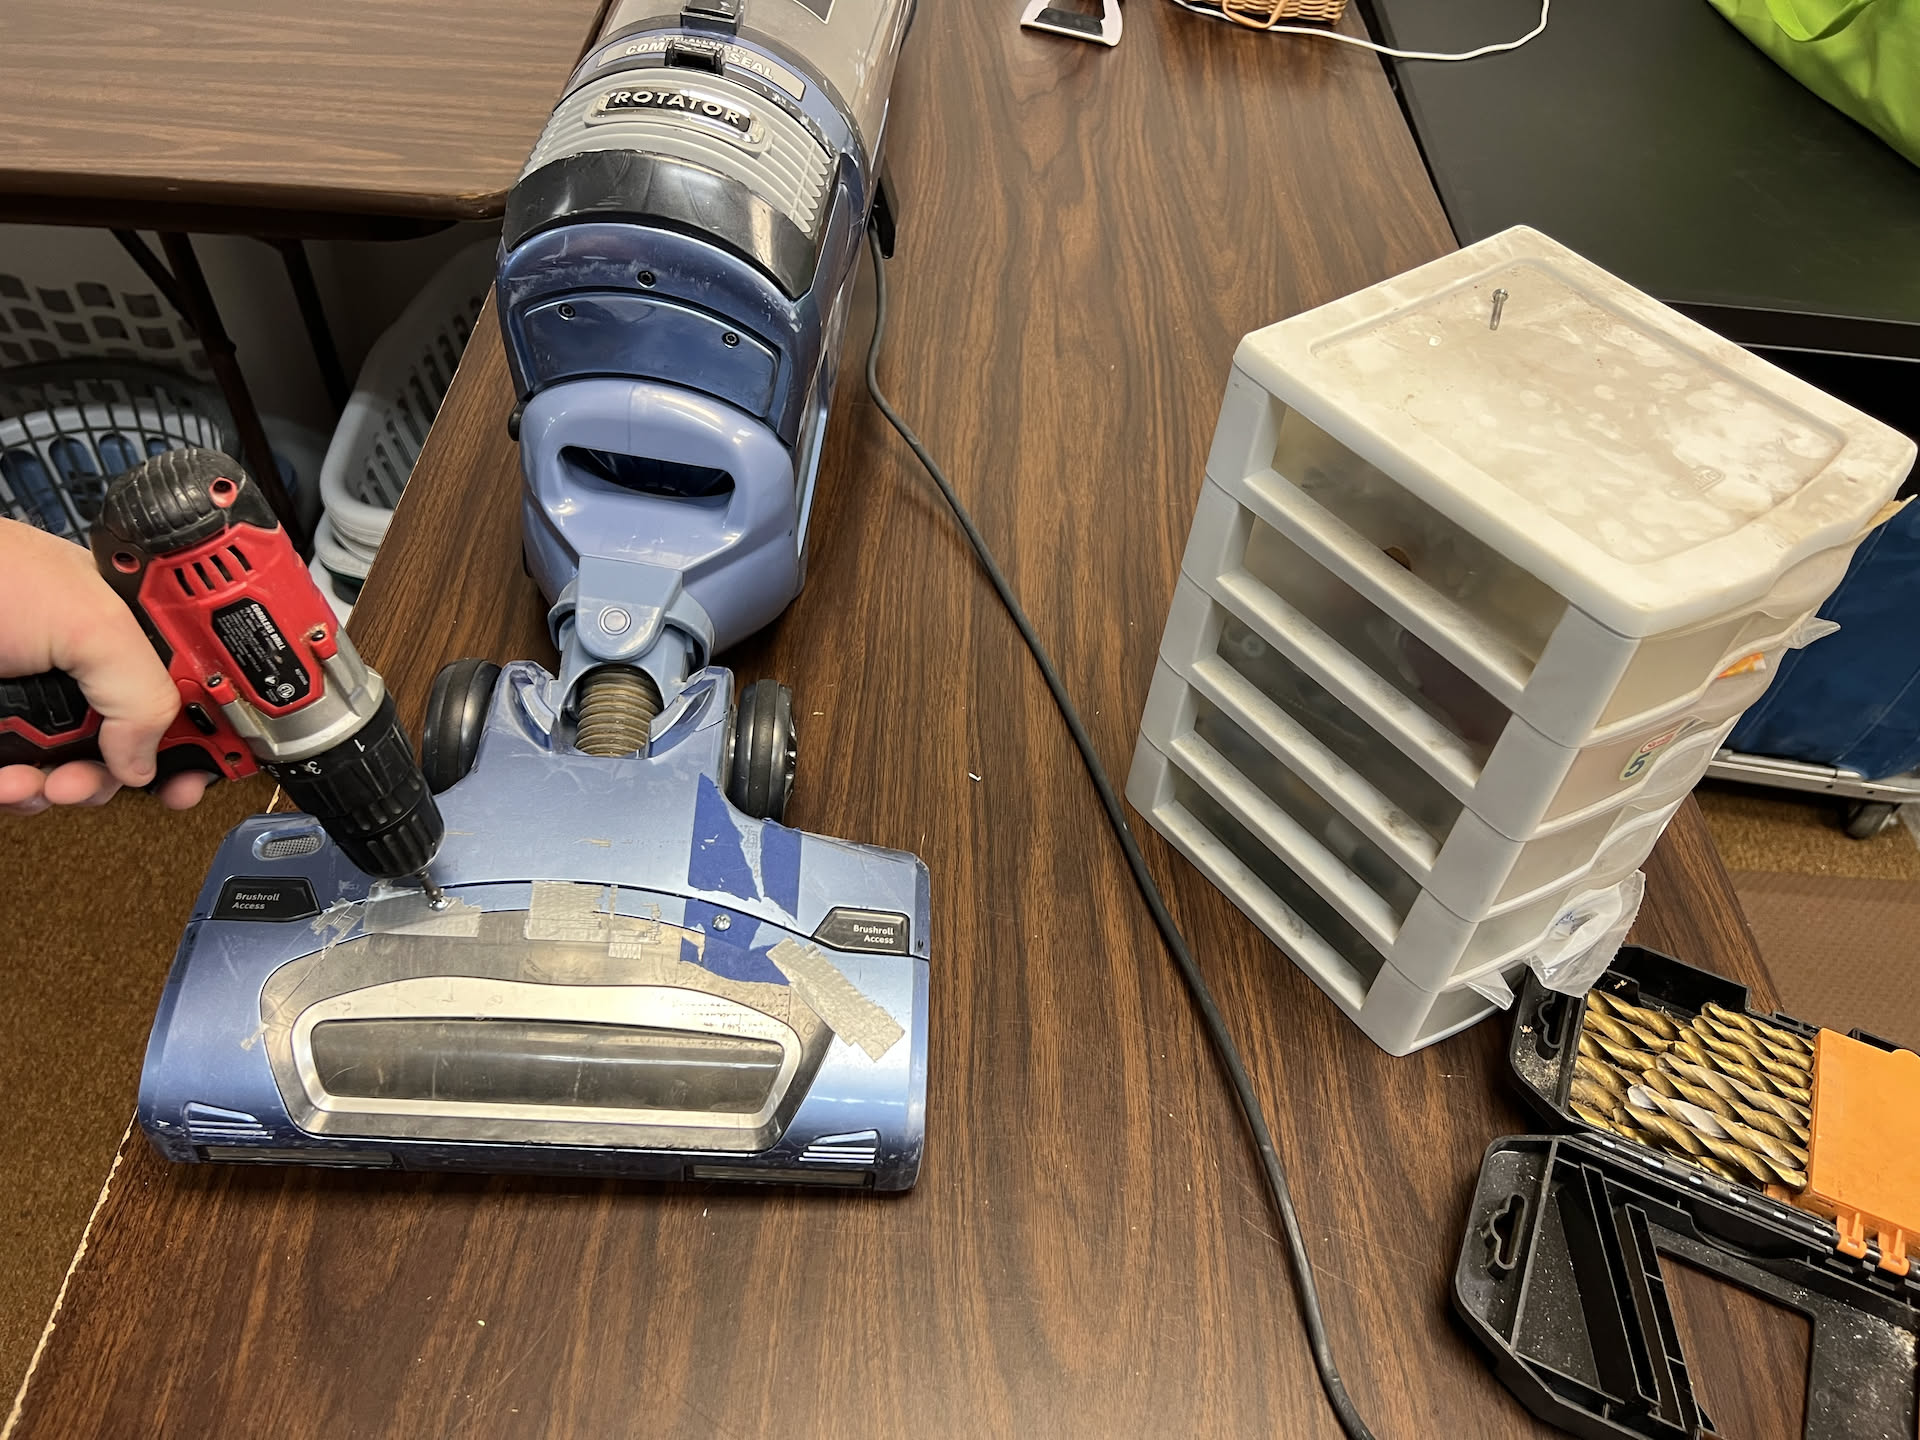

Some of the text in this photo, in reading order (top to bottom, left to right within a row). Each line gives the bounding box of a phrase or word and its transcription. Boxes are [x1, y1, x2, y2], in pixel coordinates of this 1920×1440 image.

[728, 52, 773, 80] SEAL
[614, 91, 739, 124] ROTATOR
[250, 603, 286, 650] CORDLESS DRILL
[354, 739, 365, 753] 1
[307, 761, 322, 775] 3
[1624, 751, 1651, 778] 5
[235, 892, 280, 902] Brushroll
[231, 901, 265, 911] Access
[853, 924, 894, 936] Brushroll
[863, 934, 894, 944] Access
